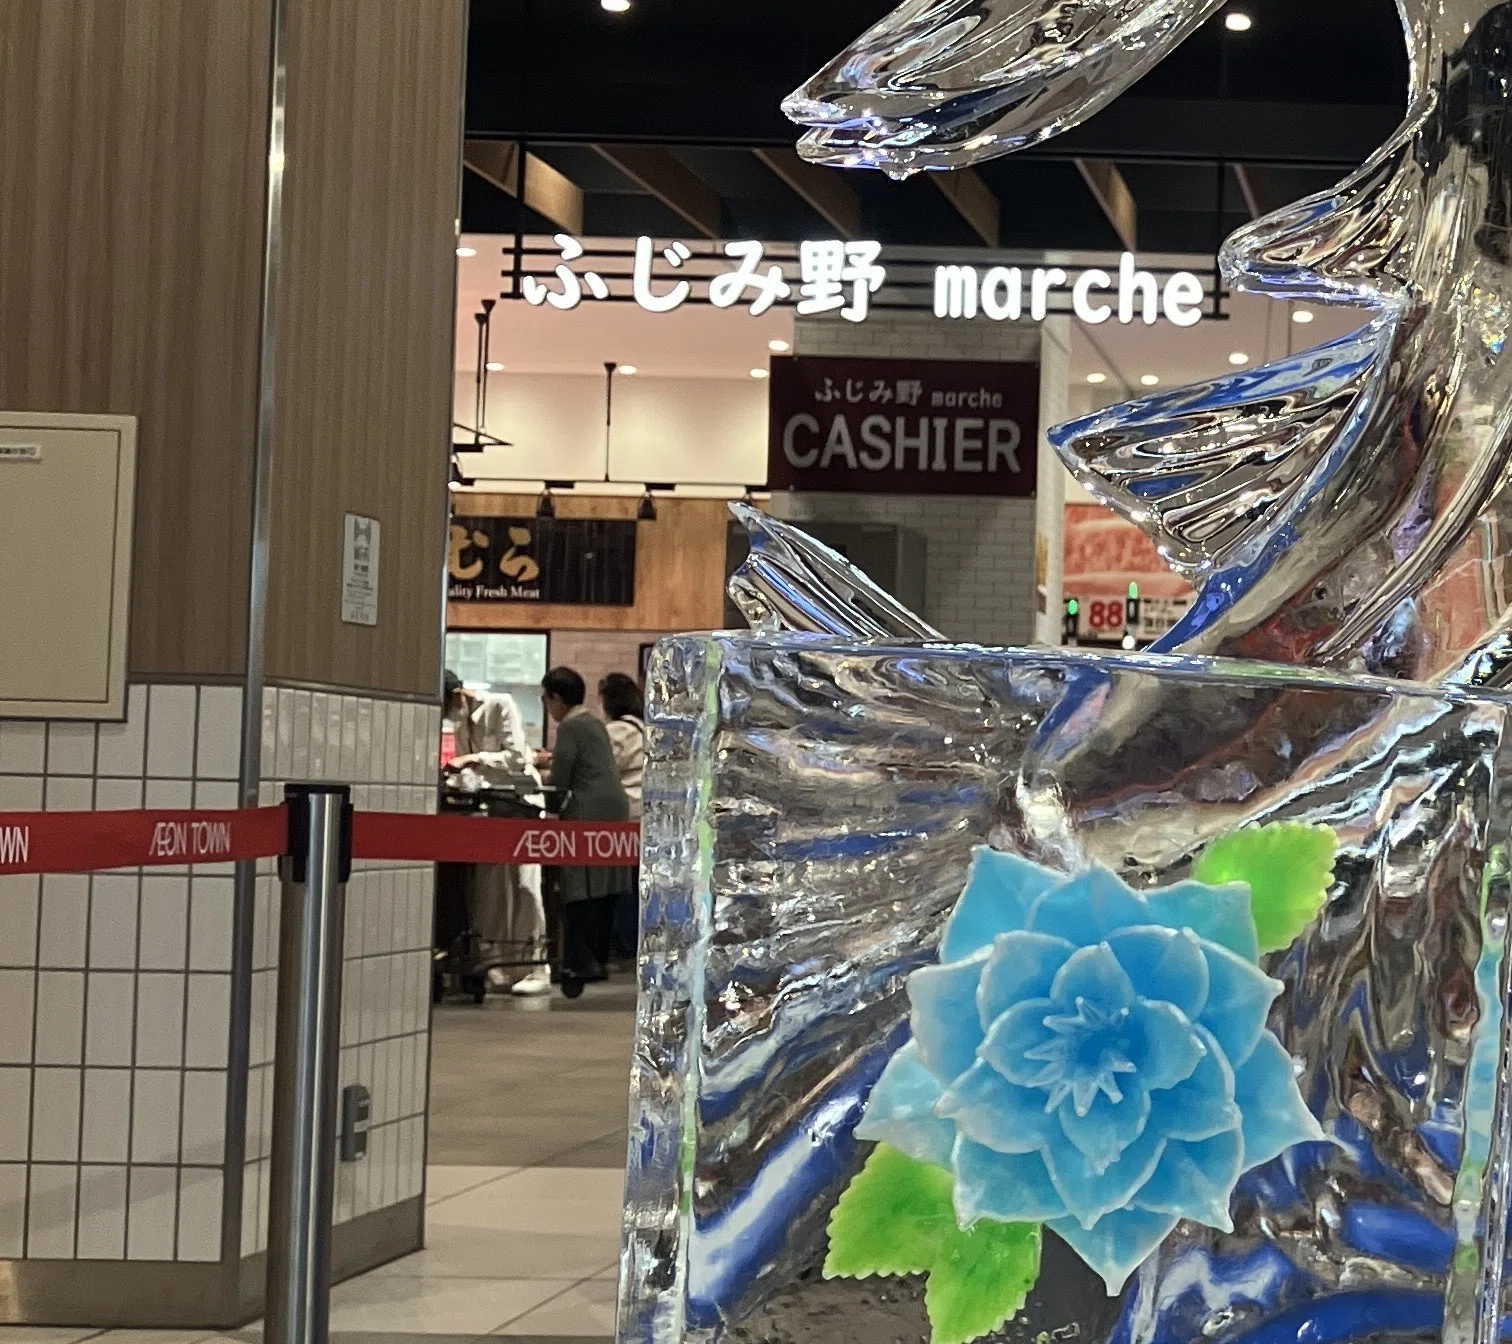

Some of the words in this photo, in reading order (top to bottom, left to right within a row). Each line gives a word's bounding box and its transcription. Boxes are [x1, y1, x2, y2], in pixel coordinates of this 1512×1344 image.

[523, 233, 885, 321] ふじみ野
[933, 251, 1204, 326] marche
[815, 377, 922, 405] ふじみ野
[931, 388, 1004, 408] marche
[783, 413, 1021, 473] CASHIER
[476, 585, 507, 598] Fresh
[510, 585, 540, 599] Meat
[191, 821, 231, 854] TOWN
